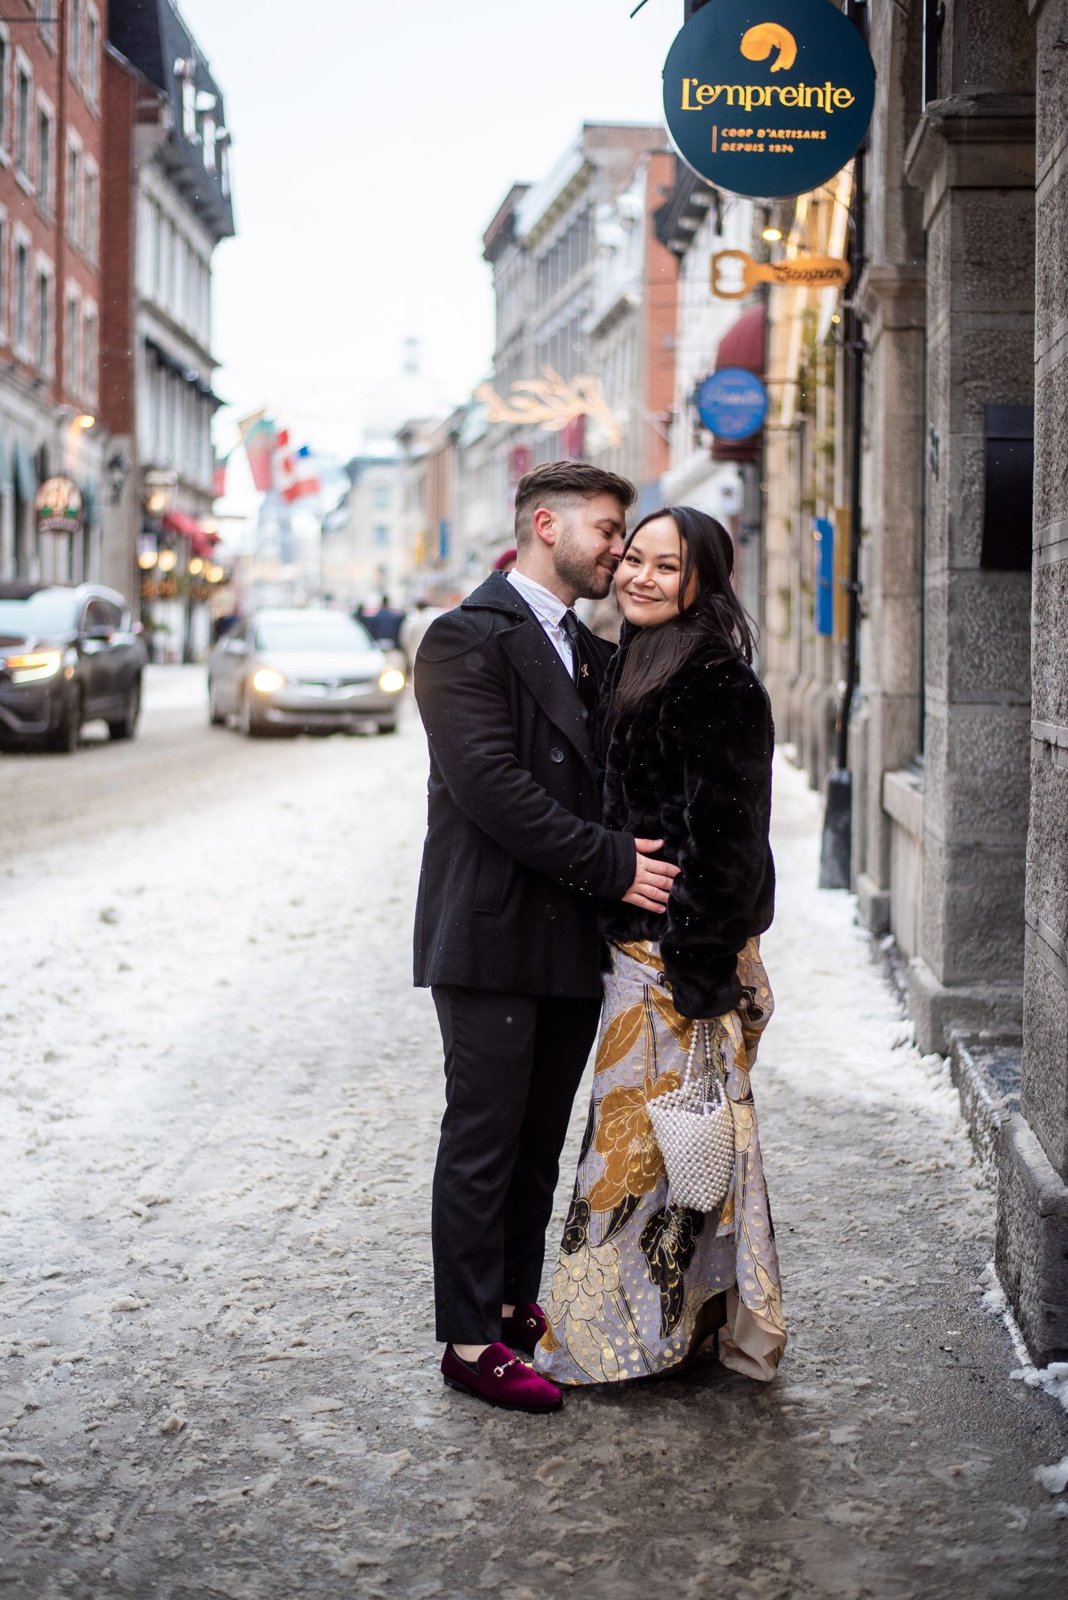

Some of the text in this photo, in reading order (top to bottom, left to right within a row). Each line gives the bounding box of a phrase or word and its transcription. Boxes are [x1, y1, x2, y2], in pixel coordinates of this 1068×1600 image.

[680, 78, 855, 114] L'empreinte
[721, 128, 827, 140] COOP D'ARTISANS
[720, 142, 794, 153] DEPUIS 1974
